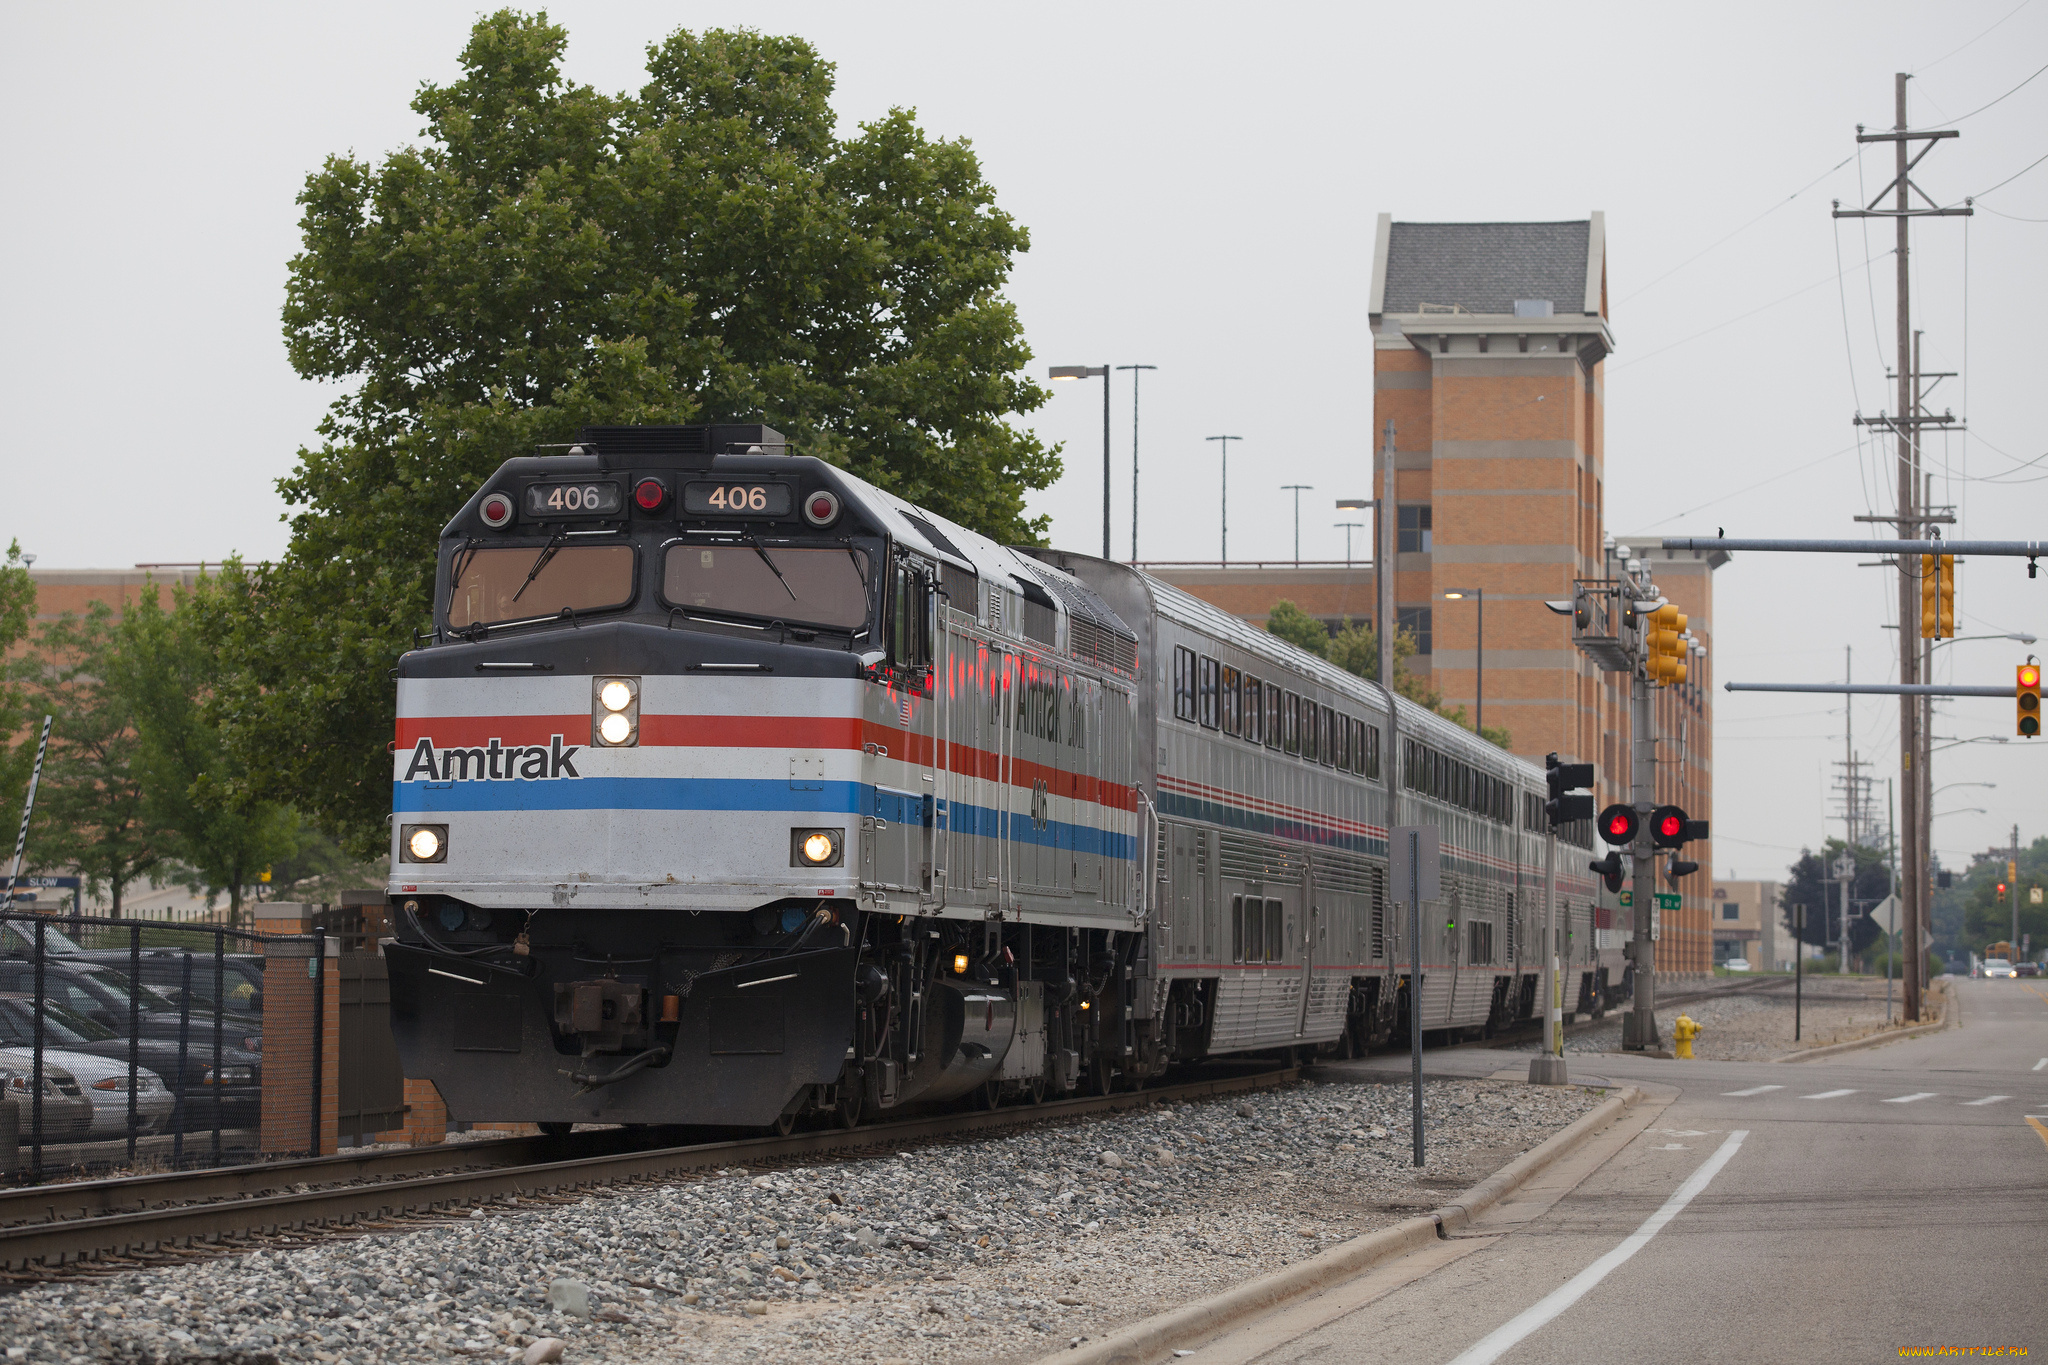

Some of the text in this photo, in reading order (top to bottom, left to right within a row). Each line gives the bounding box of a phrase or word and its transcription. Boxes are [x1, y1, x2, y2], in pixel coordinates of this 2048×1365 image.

[547, 486, 600, 510] 406
[708, 486, 767, 510] 406
[1016, 655, 1062, 743] Amtrak
[402, 735, 583, 782] Amtrak
[1031, 777, 1048, 831] 406
[29, 877, 58, 887] SLOW
